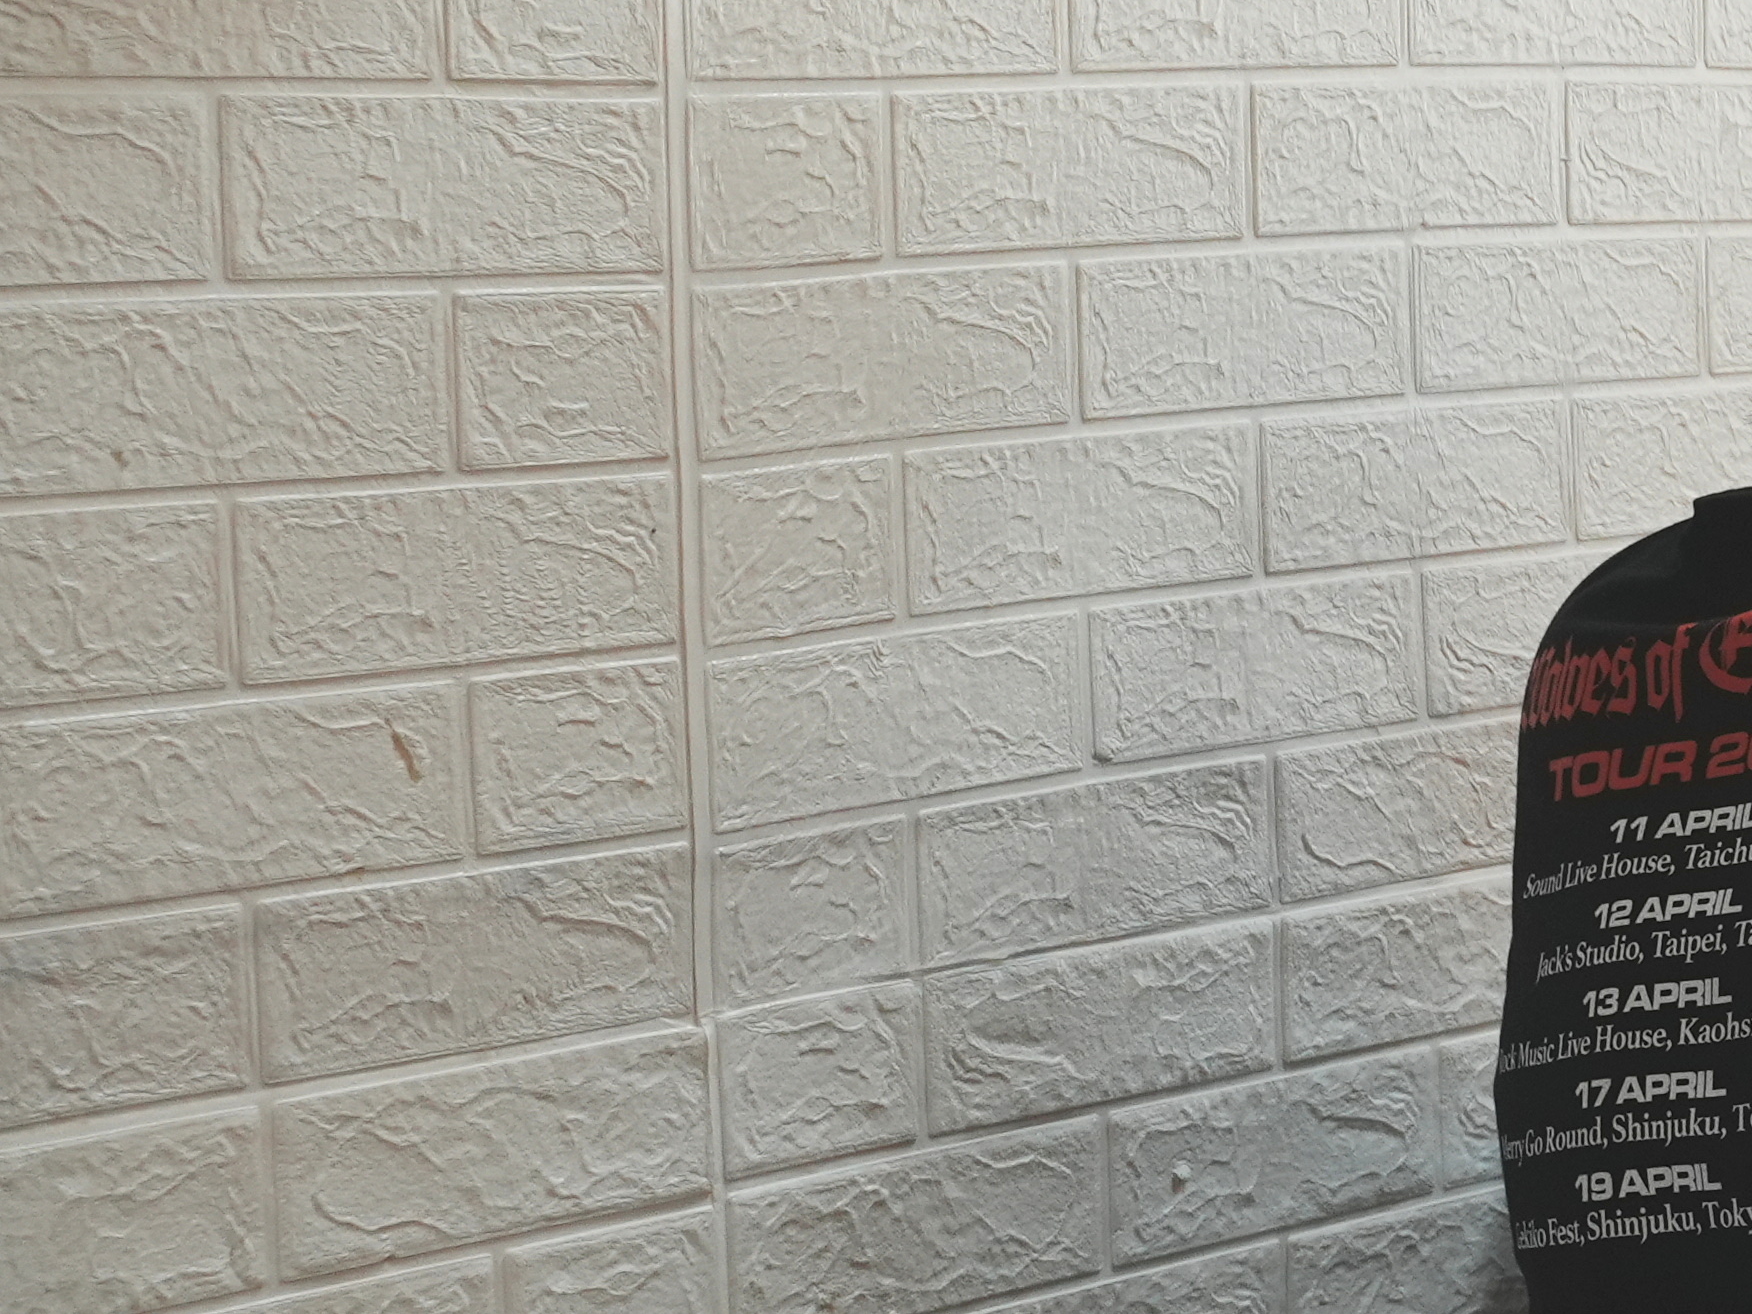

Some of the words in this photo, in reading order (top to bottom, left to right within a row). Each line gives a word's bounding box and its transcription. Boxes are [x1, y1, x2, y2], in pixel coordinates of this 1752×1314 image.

[1646, 622, 1699, 724] of
[1549, 740, 1698, 802] TOUR
[1609, 815, 1649, 844] 11
[1522, 863, 1565, 899] Sound
[1564, 860, 1598, 889] Live
[1599, 851, 1676, 881] House,
[1594, 898, 1633, 930] 12
[1634, 887, 1743, 924] APRIL
[1536, 944, 1573, 983] Jack's
[1575, 934, 1645, 969] Studio,
[1650, 923, 1728, 964] Taipei,
[1582, 987, 1620, 1018] 13
[1622, 976, 1733, 1013] APRIL
[1517, 1037, 1555, 1069] Music
[1556, 1030, 1591, 1061] Live
[1594, 1024, 1673, 1053] House,
[1574, 1078, 1612, 1109] 17
[1615, 1069, 1727, 1105] APRIL
[1525, 1129, 1544, 1157] Go
[1544, 1115, 1608, 1154] Round,
[1612, 1107, 1727, 1147] Shinjuku,
[1574, 1171, 1614, 1203] 19
[1618, 1162, 1723, 1199] APRIL
[1547, 1217, 1585, 1247] Fest,
[1586, 1203, 1702, 1244] Shinjuku,
